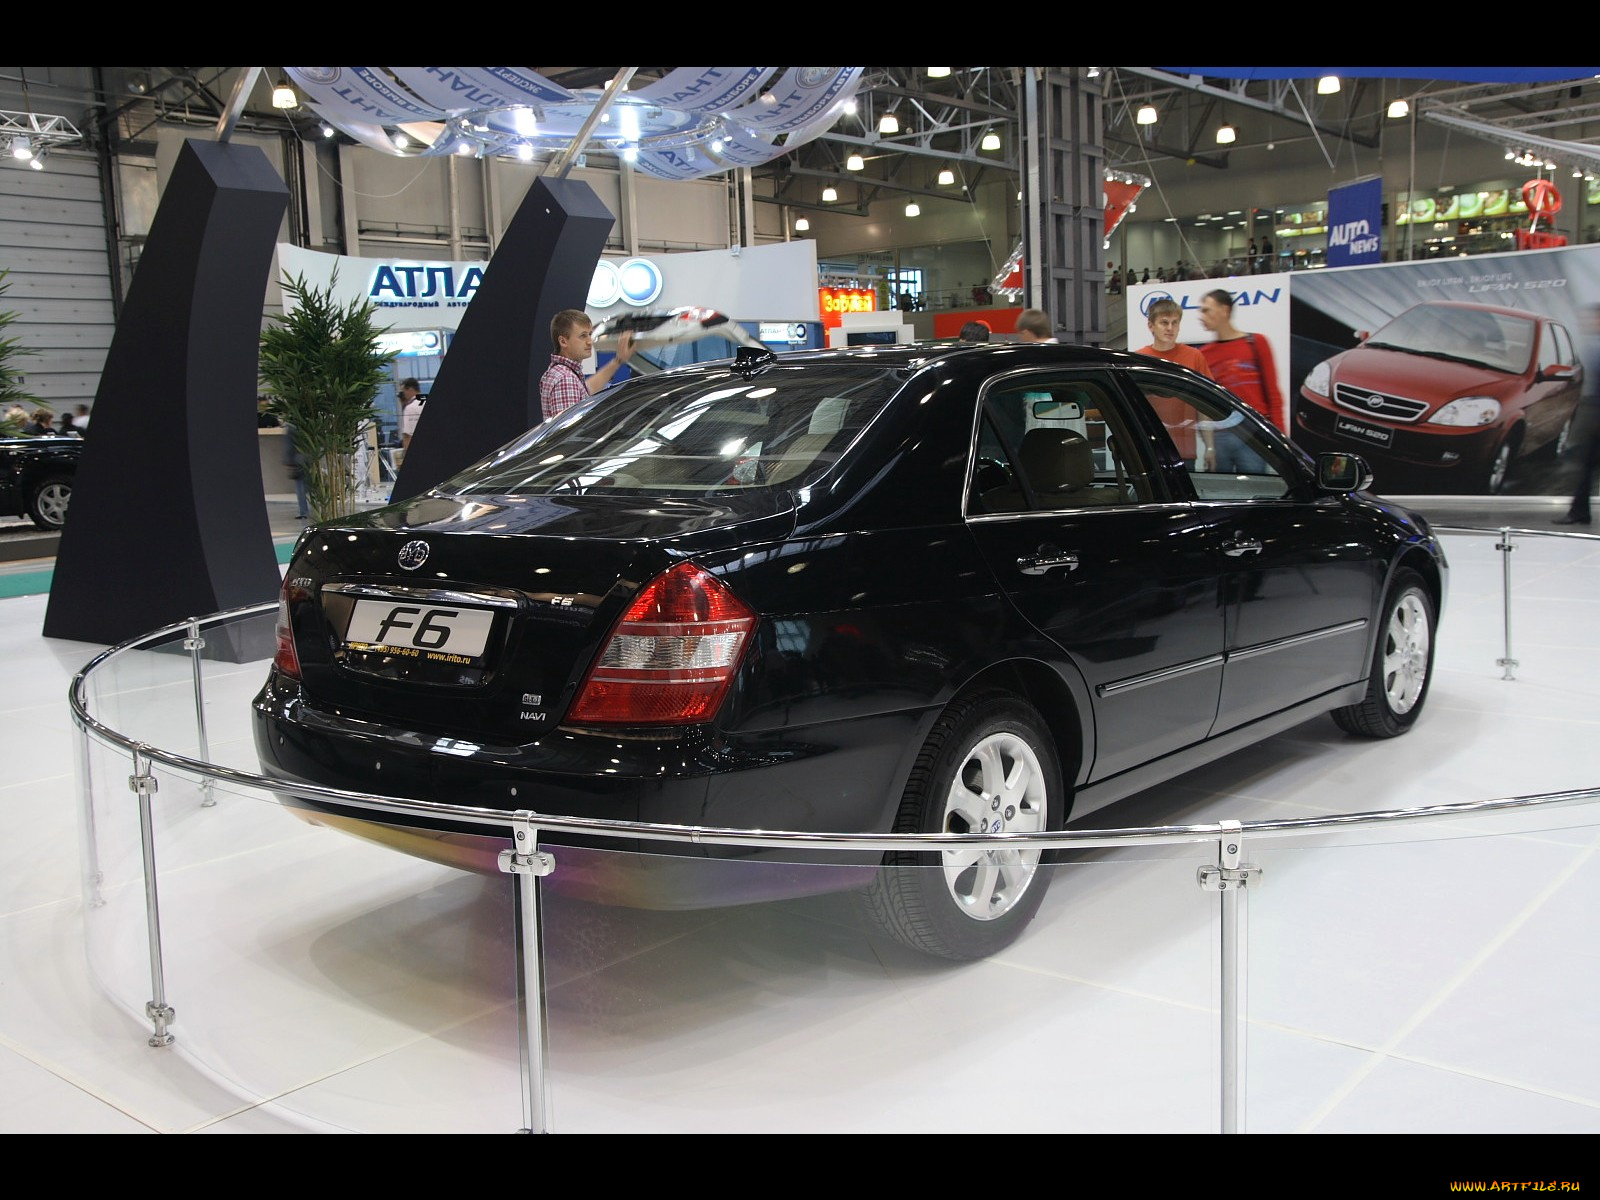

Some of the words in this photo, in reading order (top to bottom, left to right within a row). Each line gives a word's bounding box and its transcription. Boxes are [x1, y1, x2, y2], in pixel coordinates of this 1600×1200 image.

[719, 73, 757, 104] ВЫБОРЕ
[1329, 219, 1370, 247] AUTO
[1349, 237, 1379, 255] NEWS
[1468, 282, 1520, 293] LIFAN
[1523, 279, 1567, 290] 520
[1181, 288, 1281, 309] LAN
[1338, 422, 1365, 434] LIFAN
[1365, 429, 1389, 441] 520
[551, 596, 574, 607] F6
[375, 606, 459, 649] F6
[427, 651, 471, 665] www.irito.ru
[520, 711, 546, 721] NAVI
